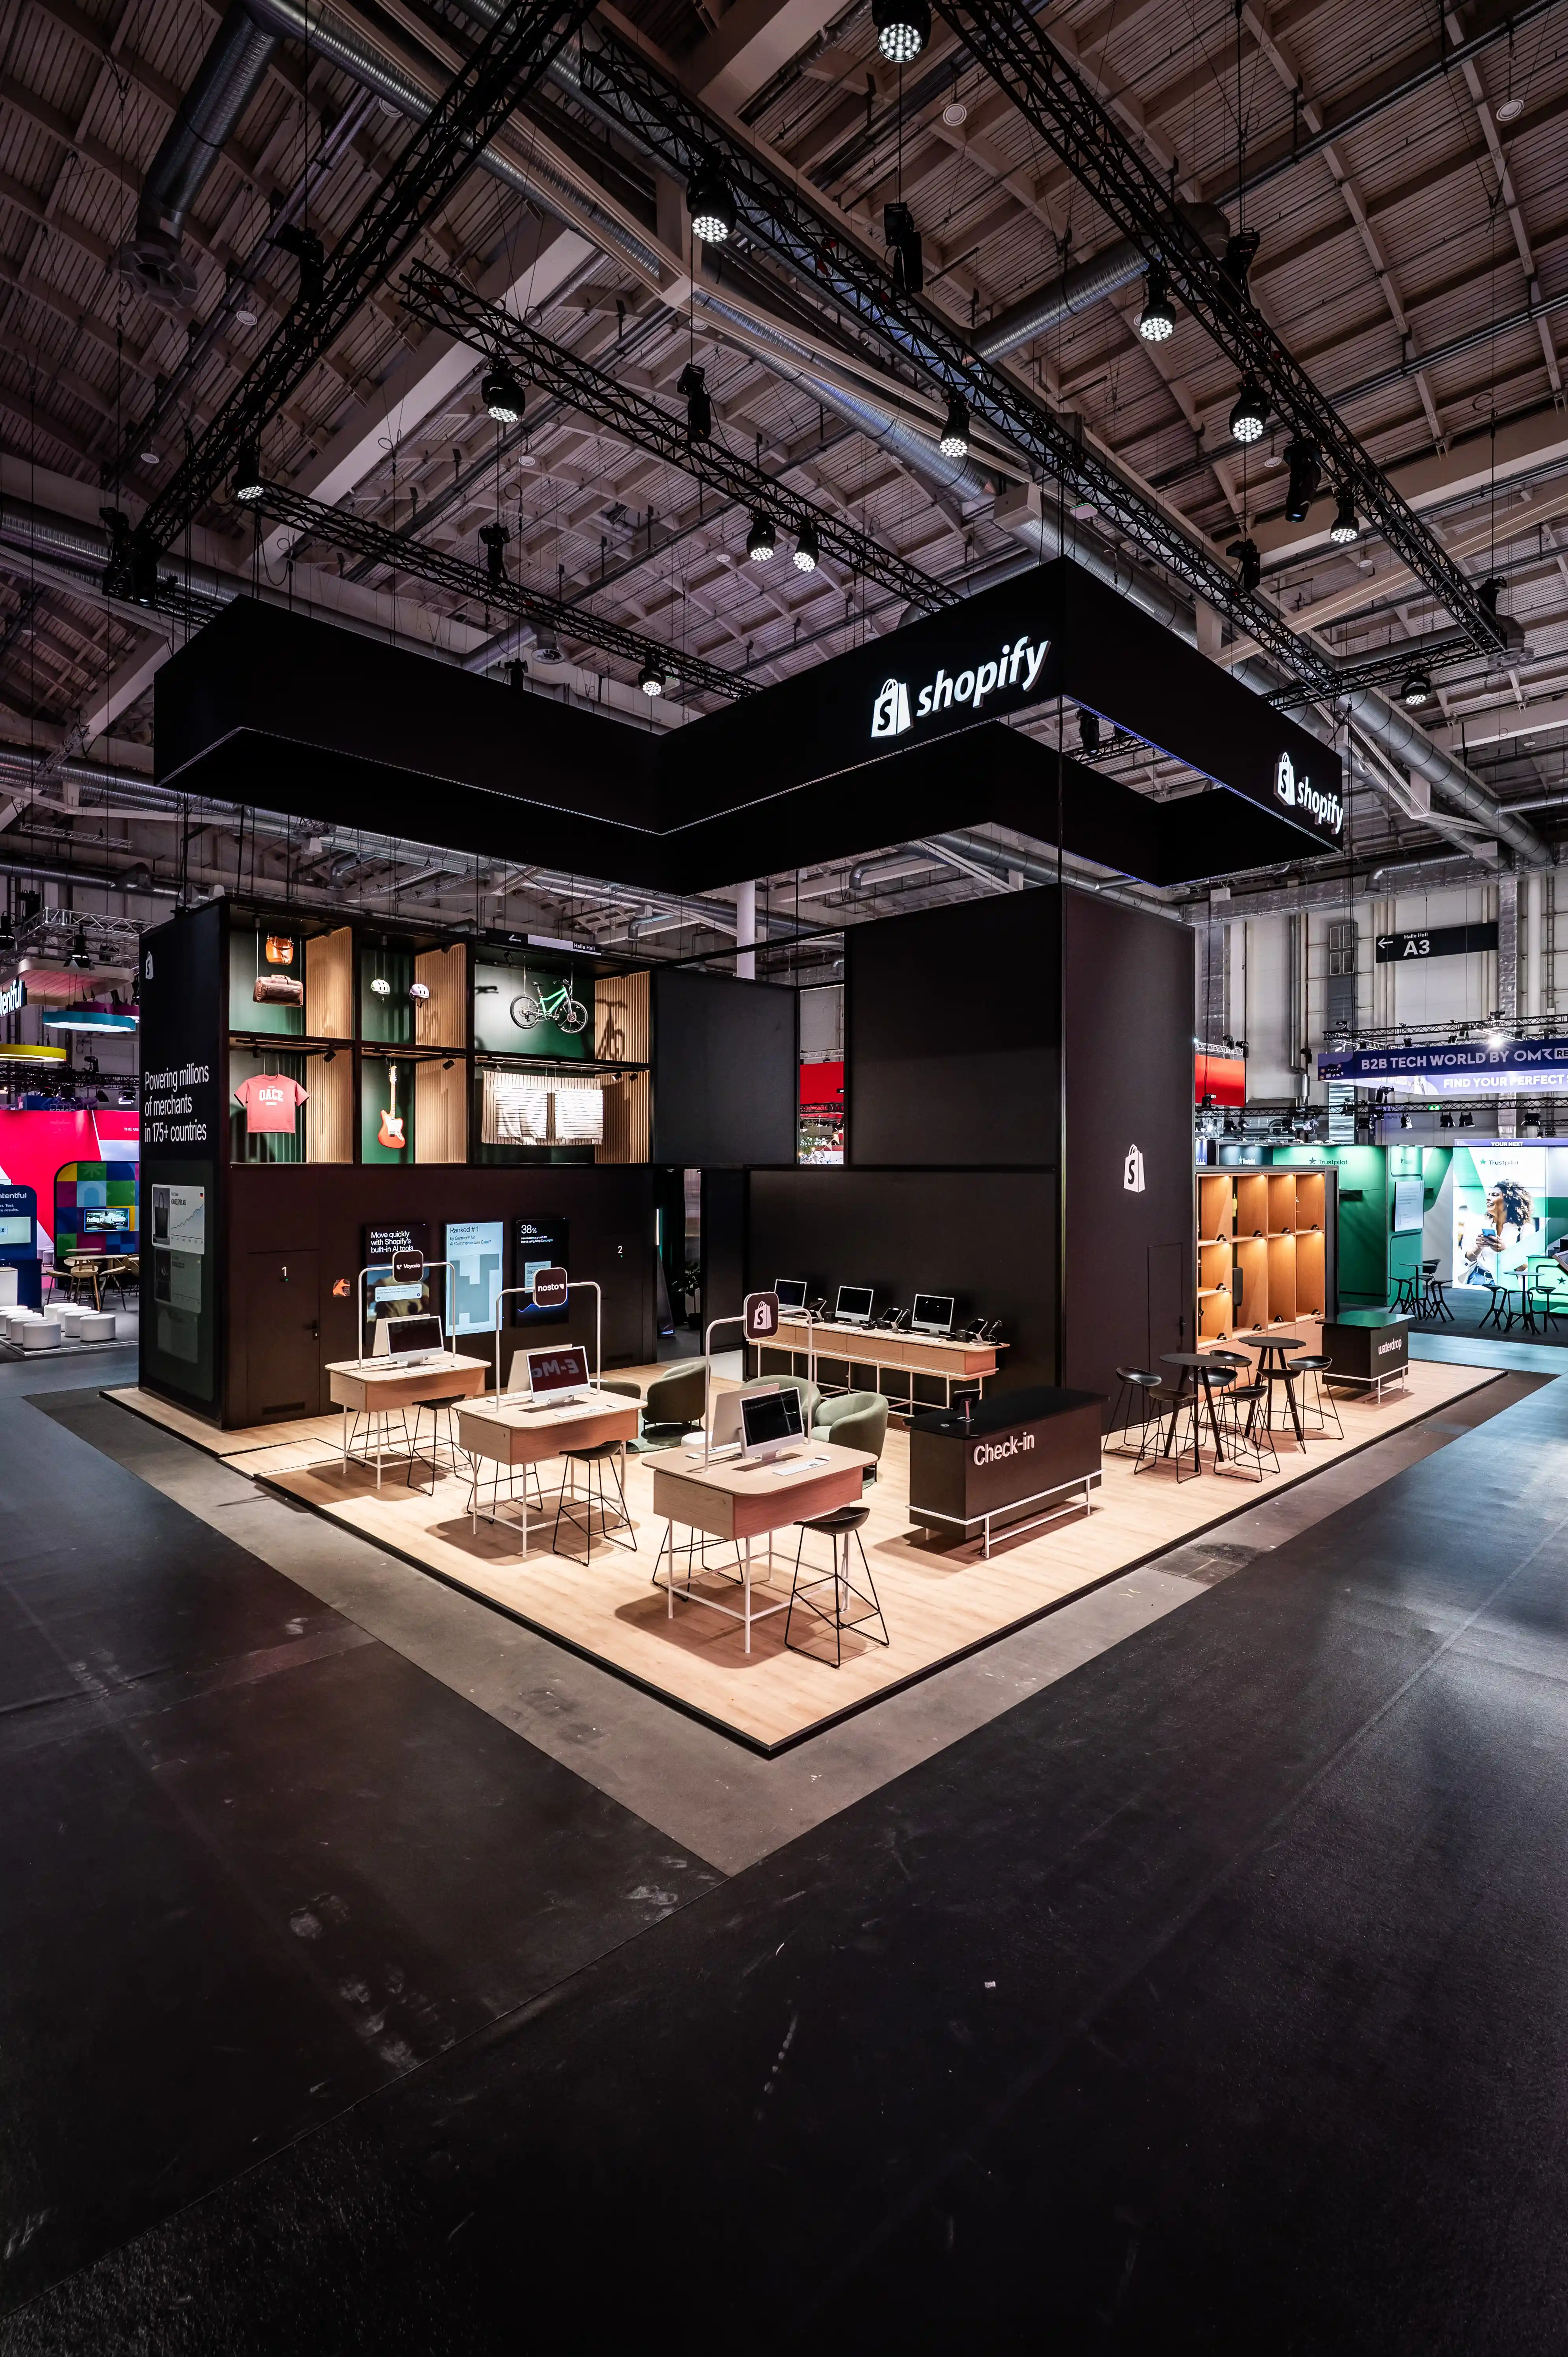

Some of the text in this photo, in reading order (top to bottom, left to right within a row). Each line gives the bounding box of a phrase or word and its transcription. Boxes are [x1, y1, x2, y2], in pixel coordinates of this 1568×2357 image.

[916, 636, 1051, 717] shopify
[1297, 776, 1344, 834] shopify
[1403, 940, 1430, 956] A3
[1361, 1058, 1387, 1070] B2B
[1390, 1056, 1426, 1068] TECH
[1429, 1053, 1486, 1066] WORLD
[1490, 1051, 1509, 1063] BY
[145, 1062, 209, 1092] Powering millions
[1443, 1078, 1471, 1088] FIND
[1473, 1077, 1507, 1087] YOUR
[1510, 1074, 1565, 1086] PERFECT
[145, 1094, 192, 1117] of merchants
[145, 1119, 207, 1142] in 175+ countries
[521, 1225, 537, 1234] 38%
[282, 1267, 286, 1276] 1
[1378, 1338, 1402, 1355] waterdrop
[974, 1432, 1034, 1465] Check-in
